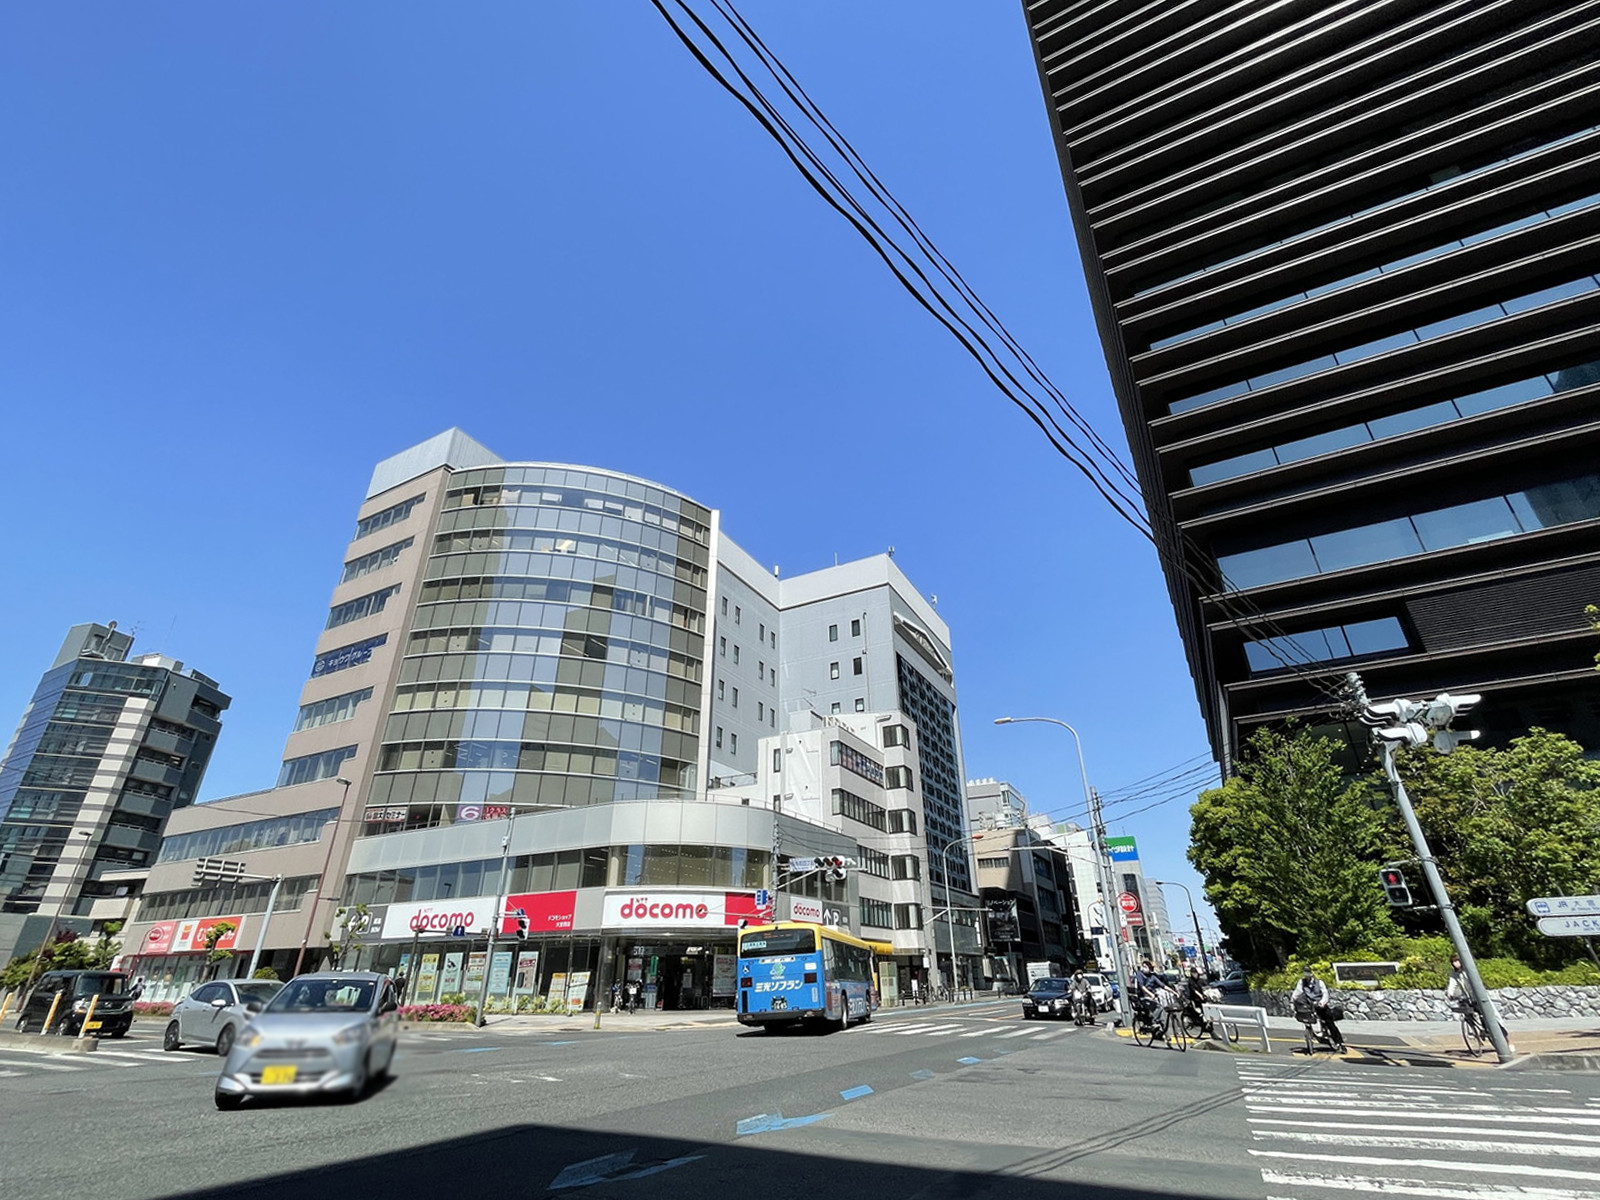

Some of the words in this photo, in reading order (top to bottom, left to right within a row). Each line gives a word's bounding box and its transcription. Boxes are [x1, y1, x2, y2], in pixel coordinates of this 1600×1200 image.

[620, 897, 709, 919] docomo
[793, 902, 821, 918] docomo
[1557, 900, 1569, 909] JR
[409, 908, 475, 931] docomo
[1564, 920, 1600, 929] JACK
[754, 980, 803, 993] 三光ソフラン
